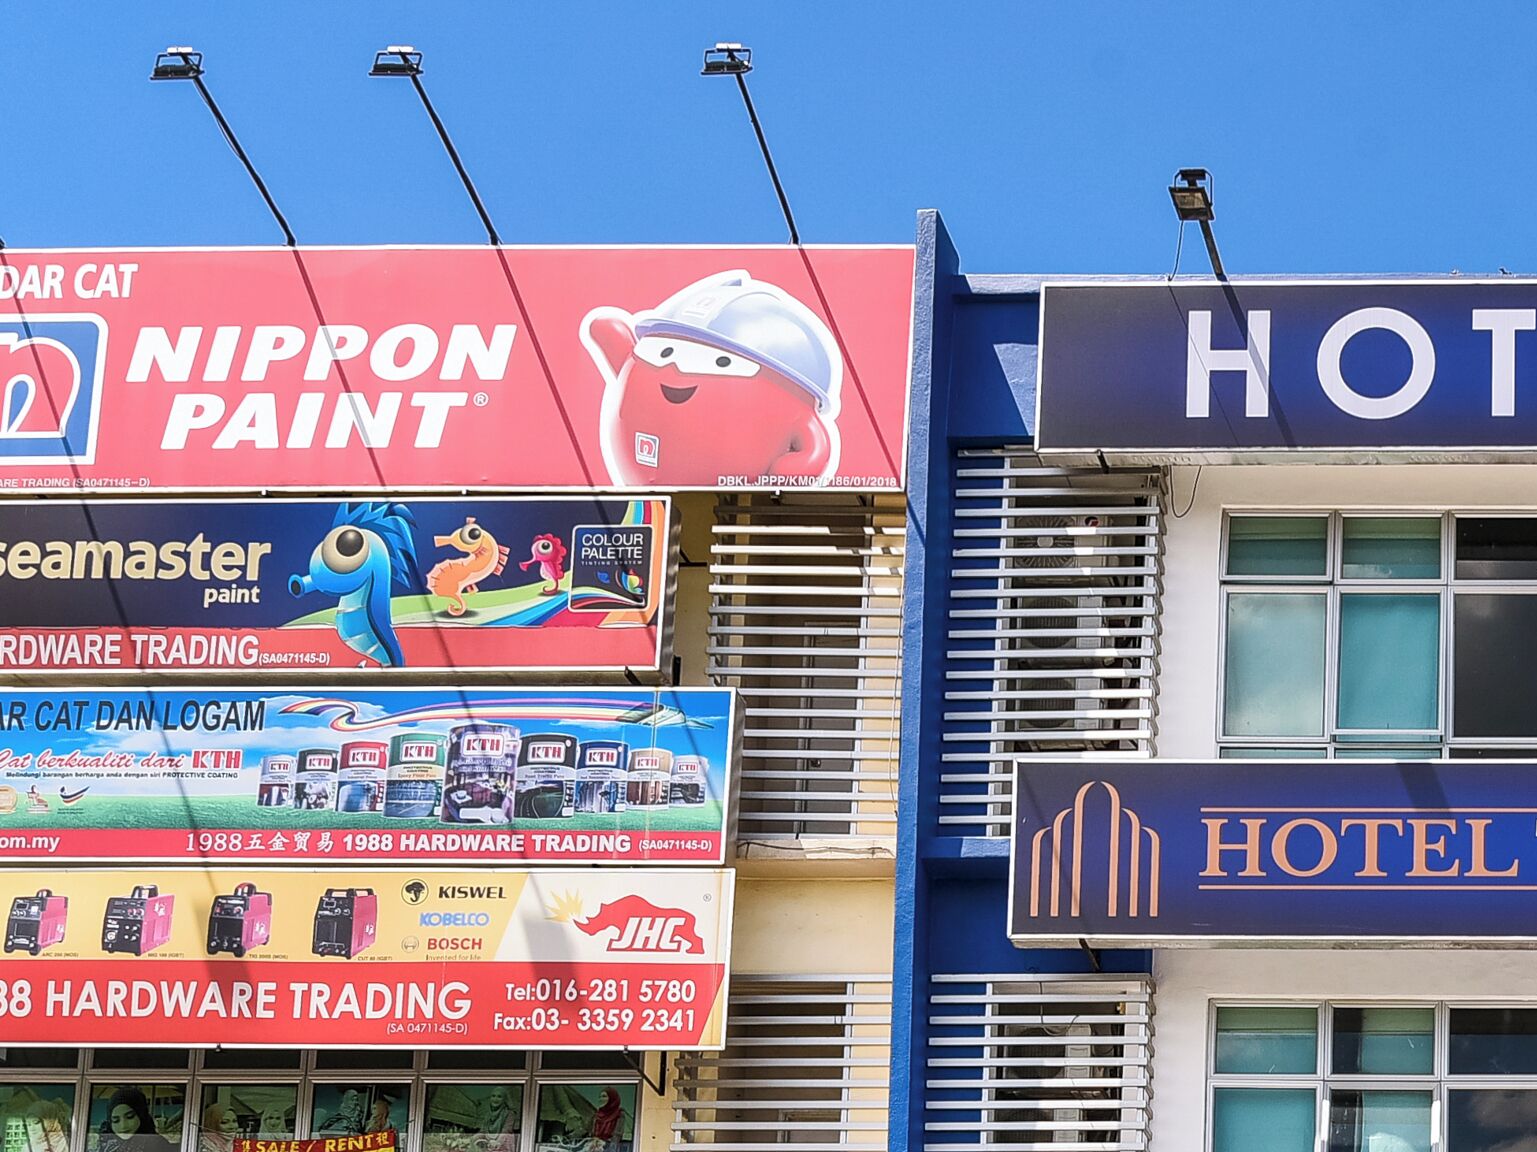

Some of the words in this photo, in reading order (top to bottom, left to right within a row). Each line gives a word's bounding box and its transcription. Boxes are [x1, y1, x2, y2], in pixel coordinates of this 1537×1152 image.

[73, 263, 139, 299] CAT
[125, 323, 517, 382] NIPPON
[22, 477, 71, 488] TRADING
[582, 533, 644, 547] COLOUR
[581, 546, 643, 559] PALETTE
[203, 584, 260, 609] paint
[131, 634, 259, 666] TRADING
[258, 651, 331, 667] (SA0471145-D)
[34, 700, 90, 731] CAT
[95, 700, 154, 731] DAN
[163, 700, 266, 731] LOGAM
[466, 738, 501, 752] KTH
[531, 746, 562, 759] KTH
[37, 749, 135, 769] berkualiti
[140, 751, 185, 769] dari
[192, 750, 242, 769] KTH
[342, 833, 393, 852] 1988
[399, 834, 524, 852] HARDWARE
[532, 834, 631, 853] TRADING
[638, 839, 713, 853] (SA0471145-D)
[1199, 817, 1520, 879] HOTEL
[438, 885, 508, 900] KISWEL
[418, 912, 490, 927] KOBELCO
[612, 916, 686, 950] JHC
[426, 937, 483, 951] BOSCH
[45, 980, 277, 1019] HARDWARE
[289, 981, 472, 1021] TRADING
[505, 978, 629, 1003] Tel:016-281
[638, 979, 696, 1004] 5780
[386, 1022, 405, 1036] (SA
[407, 1022, 468, 1036] 0471145-D)
[577, 1008, 634, 1032] 3359
[640, 1008, 695, 1032] 2341
